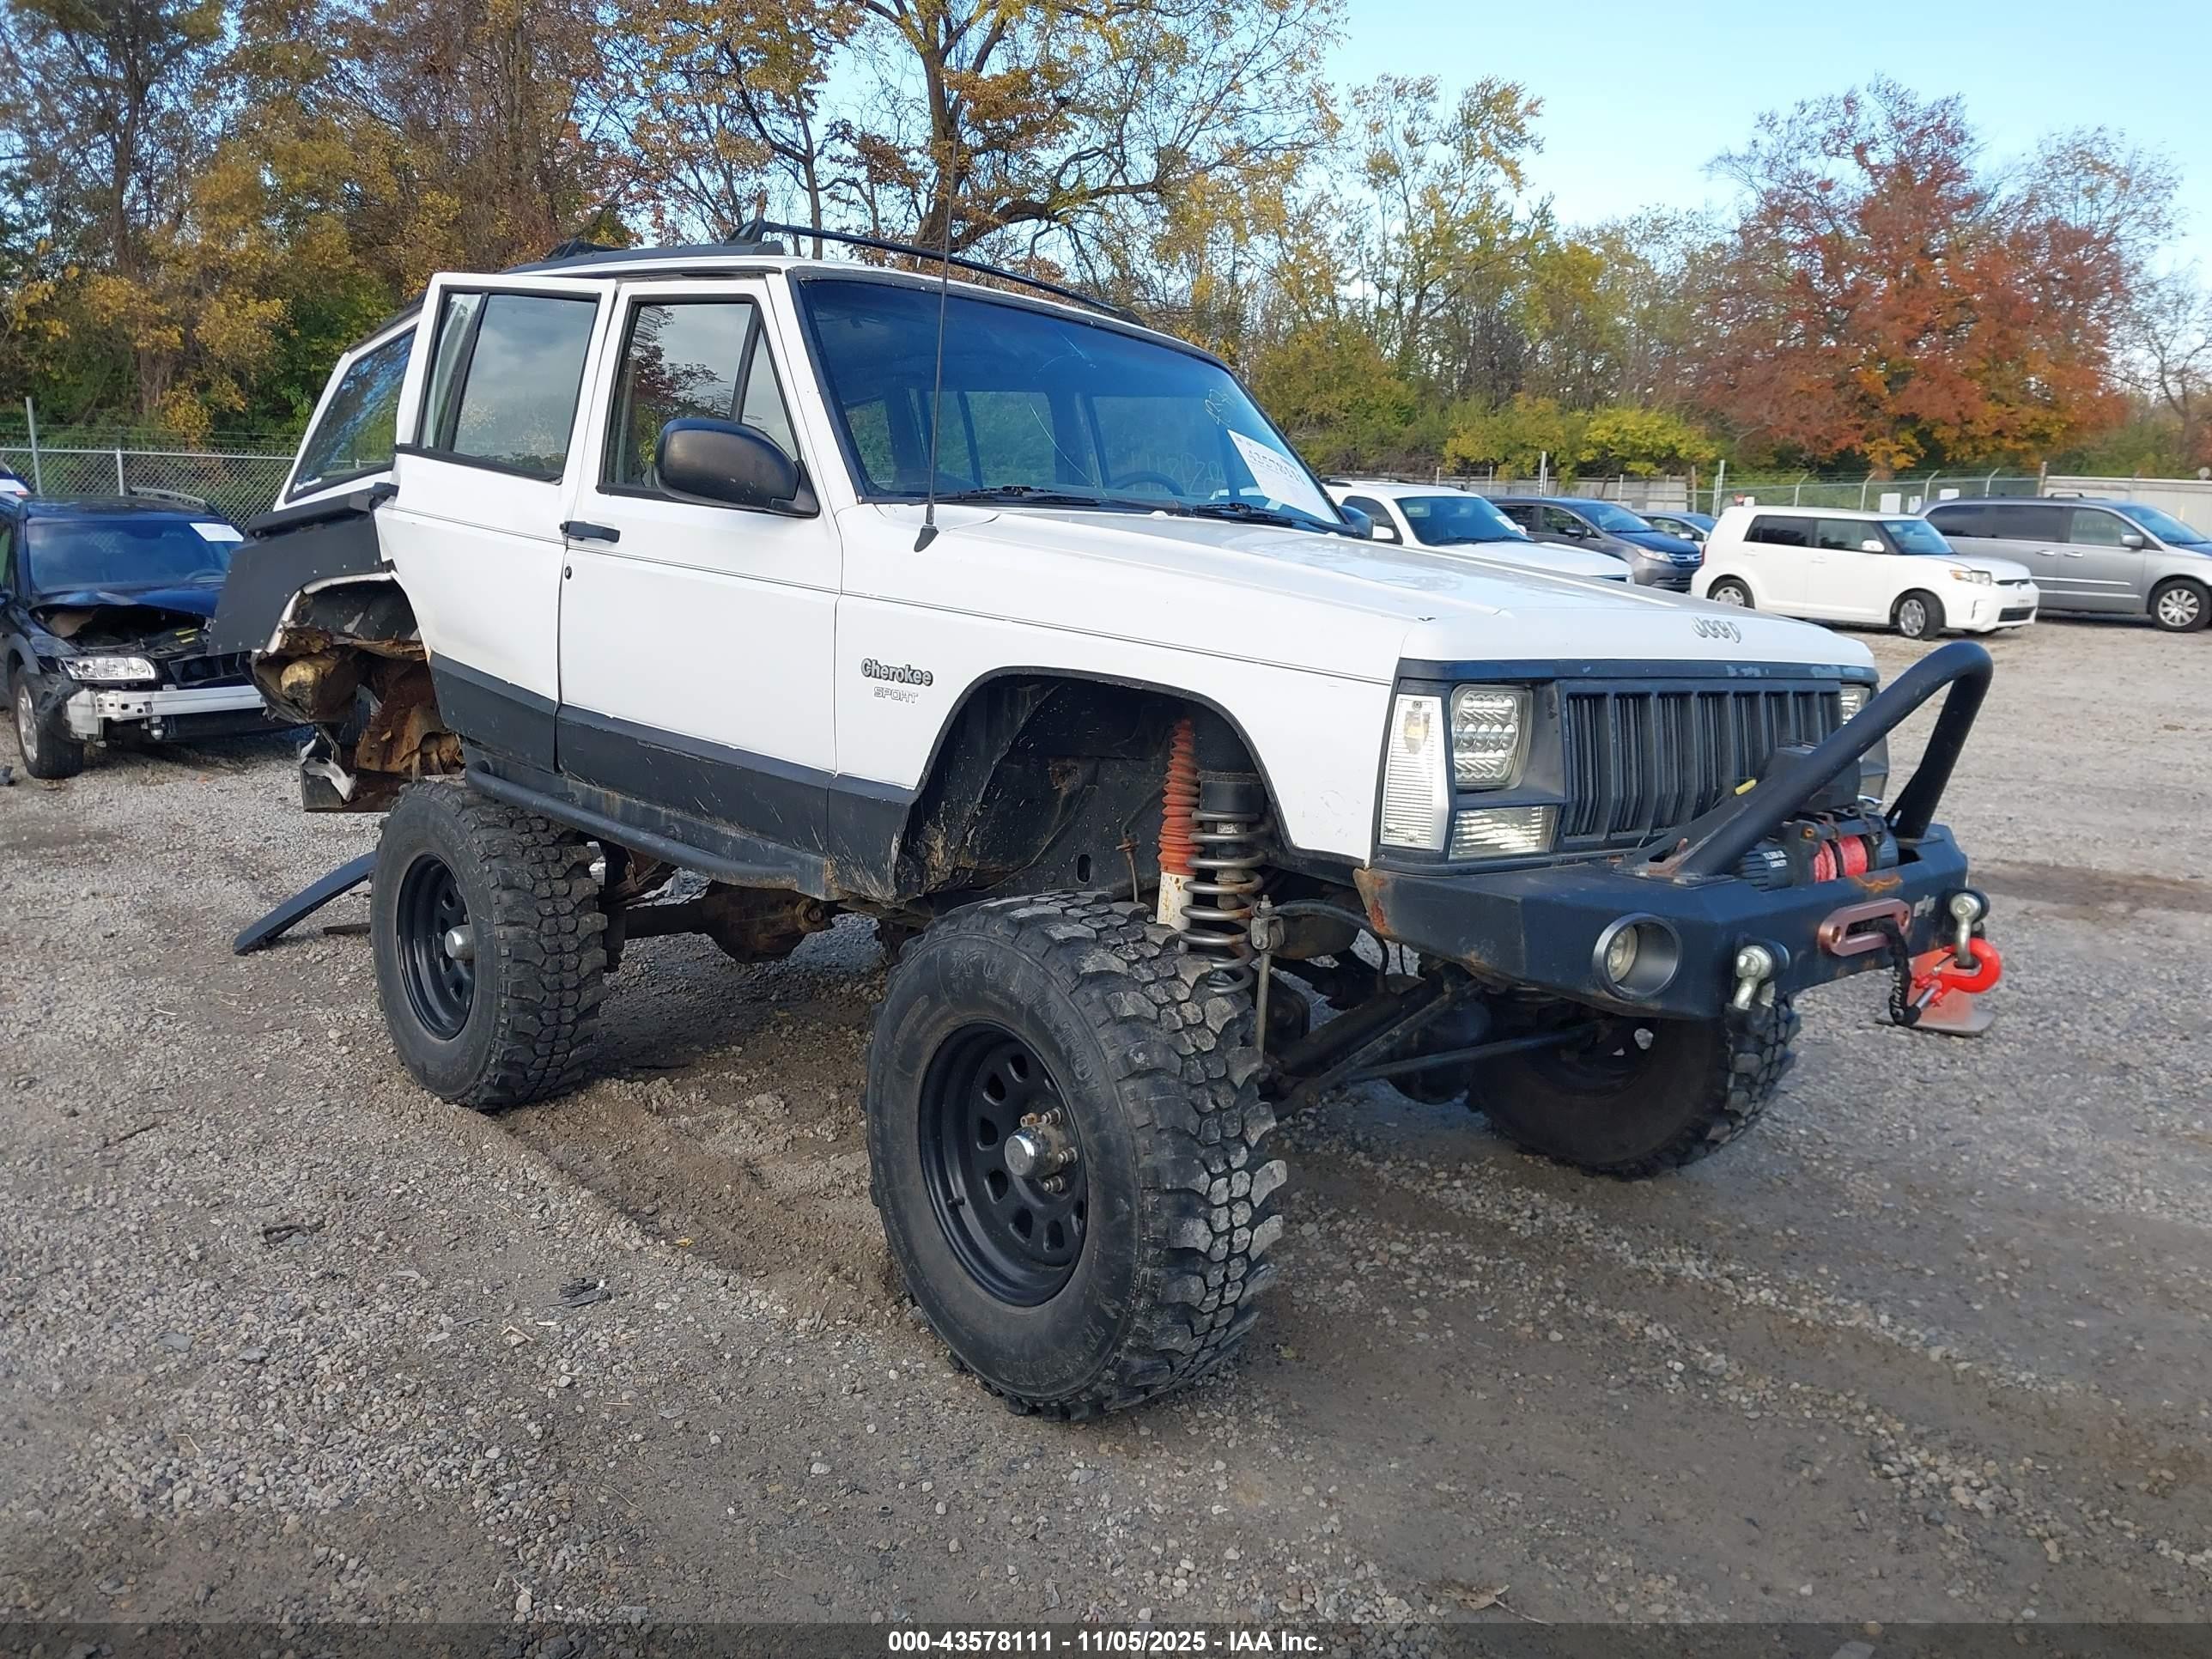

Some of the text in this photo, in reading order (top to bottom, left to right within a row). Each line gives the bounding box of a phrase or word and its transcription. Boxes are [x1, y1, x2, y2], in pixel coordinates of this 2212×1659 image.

[1691, 617, 1741, 643] Jeep
[861, 658, 933, 686] Cherokee
[873, 687, 919, 703] SPORT
